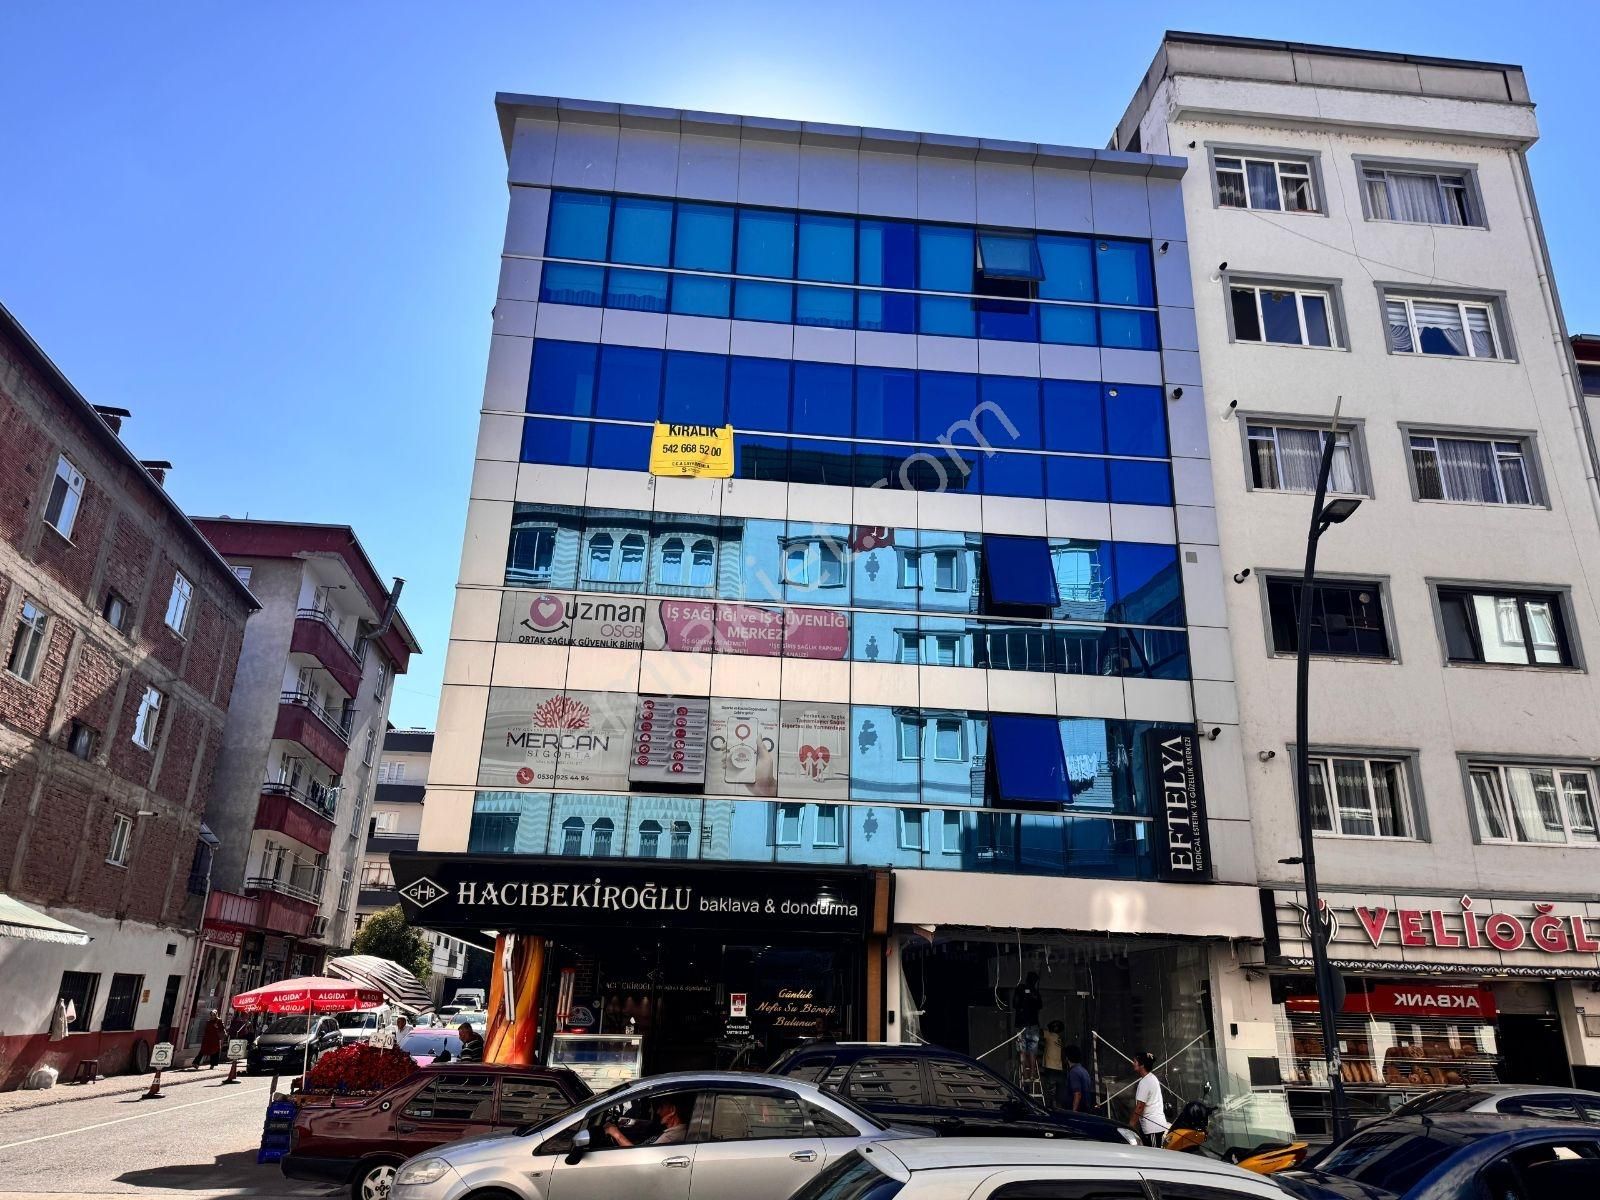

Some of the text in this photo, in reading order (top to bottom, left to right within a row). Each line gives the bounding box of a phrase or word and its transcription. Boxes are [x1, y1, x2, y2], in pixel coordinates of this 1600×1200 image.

[662, 444, 721, 456] 542 668 52 00
[564, 601, 645, 623] uzman
[667, 603, 679, 622] İŞ
[741, 613, 756, 623] ve
[760, 610, 772, 626] İŞ
[601, 624, 642, 639] OSGB
[727, 626, 788, 641] MERKEZİ
[518, 635, 545, 644] ORTAK
[578, 638, 618, 648] GÜVENLİK
[506, 731, 610, 752] MERCAN
[1184, 737, 1193, 765] MERKEZİ
[537, 773, 554, 781] 0530
[1186, 767, 1197, 798] GÜZELLİK
[1189, 800, 1198, 809] VE
[409, 884, 436, 901] GHB
[457, 878, 858, 917] HACIBEKİROĞLU baklava & dondurma
[273, 993, 302, 1002] ALGIDA
[778, 988, 814, 999] Günlük
[755, 1001, 836, 1015] Nefis Su Böreği
[773, 1016, 817, 1027] Bulunur
